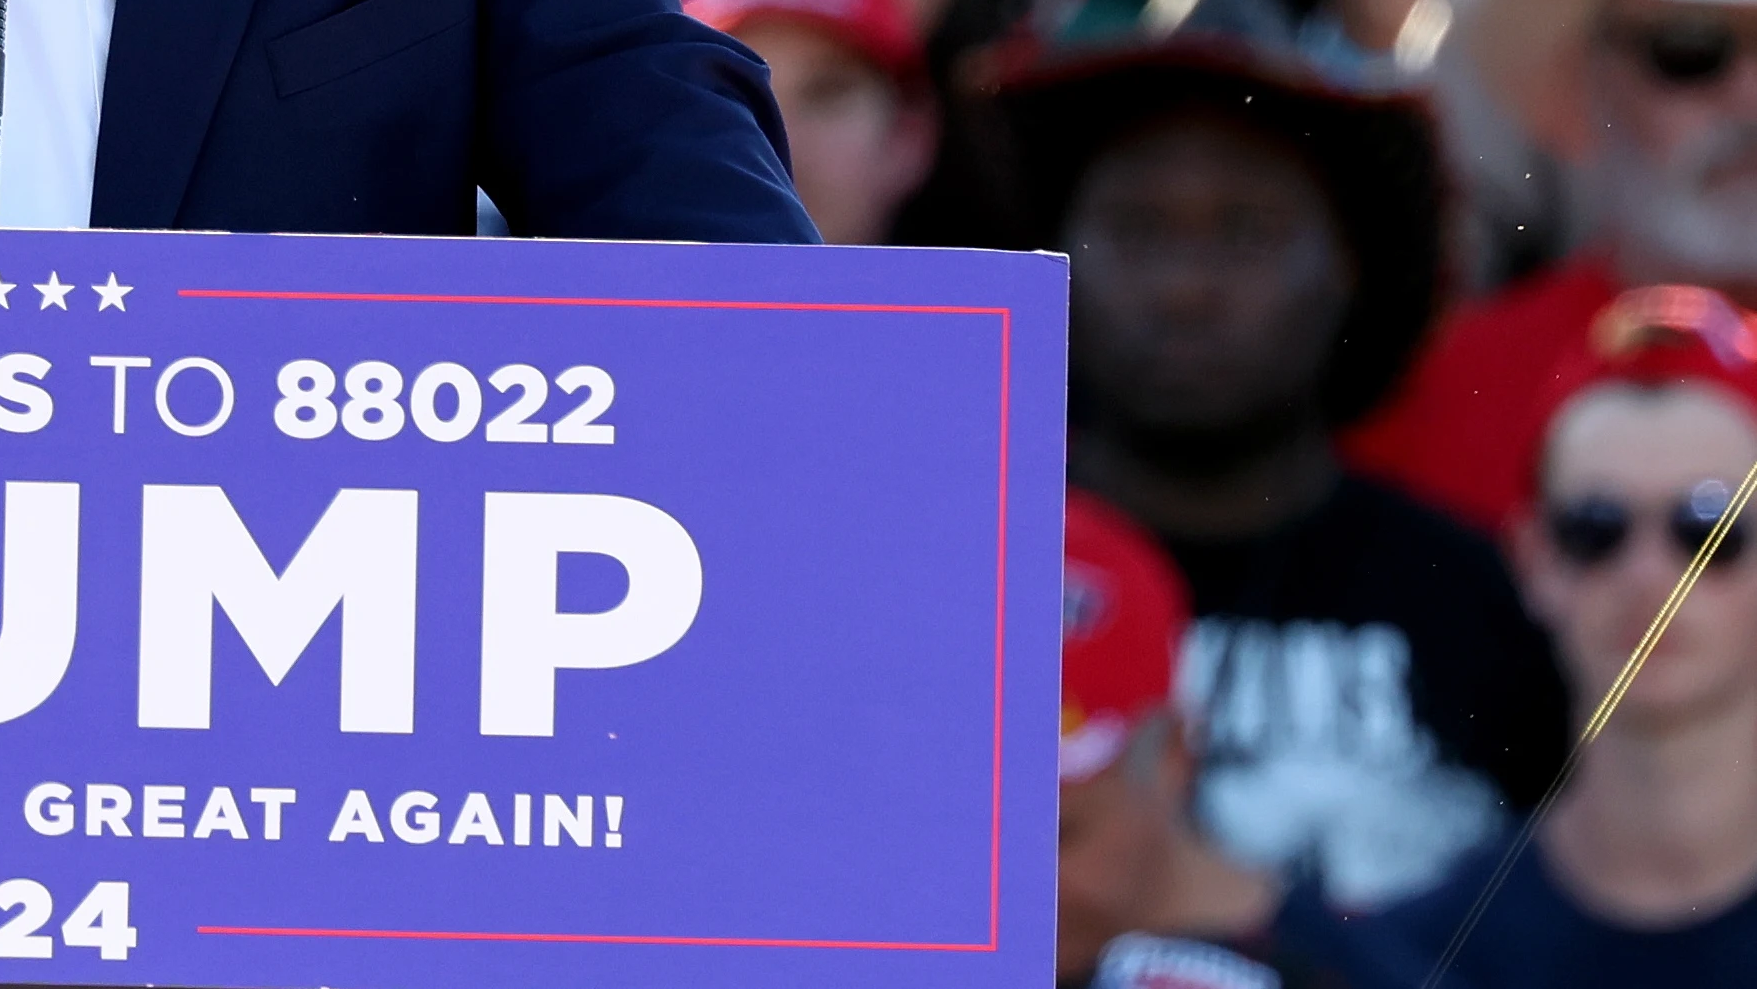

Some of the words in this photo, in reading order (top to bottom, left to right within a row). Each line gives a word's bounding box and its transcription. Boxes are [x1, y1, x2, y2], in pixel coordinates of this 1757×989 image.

[89, 355, 235, 437] TO
[273, 359, 615, 445] 88022
[23, 781, 297, 841] GREAT
[328, 789, 624, 848] AGAIN!
